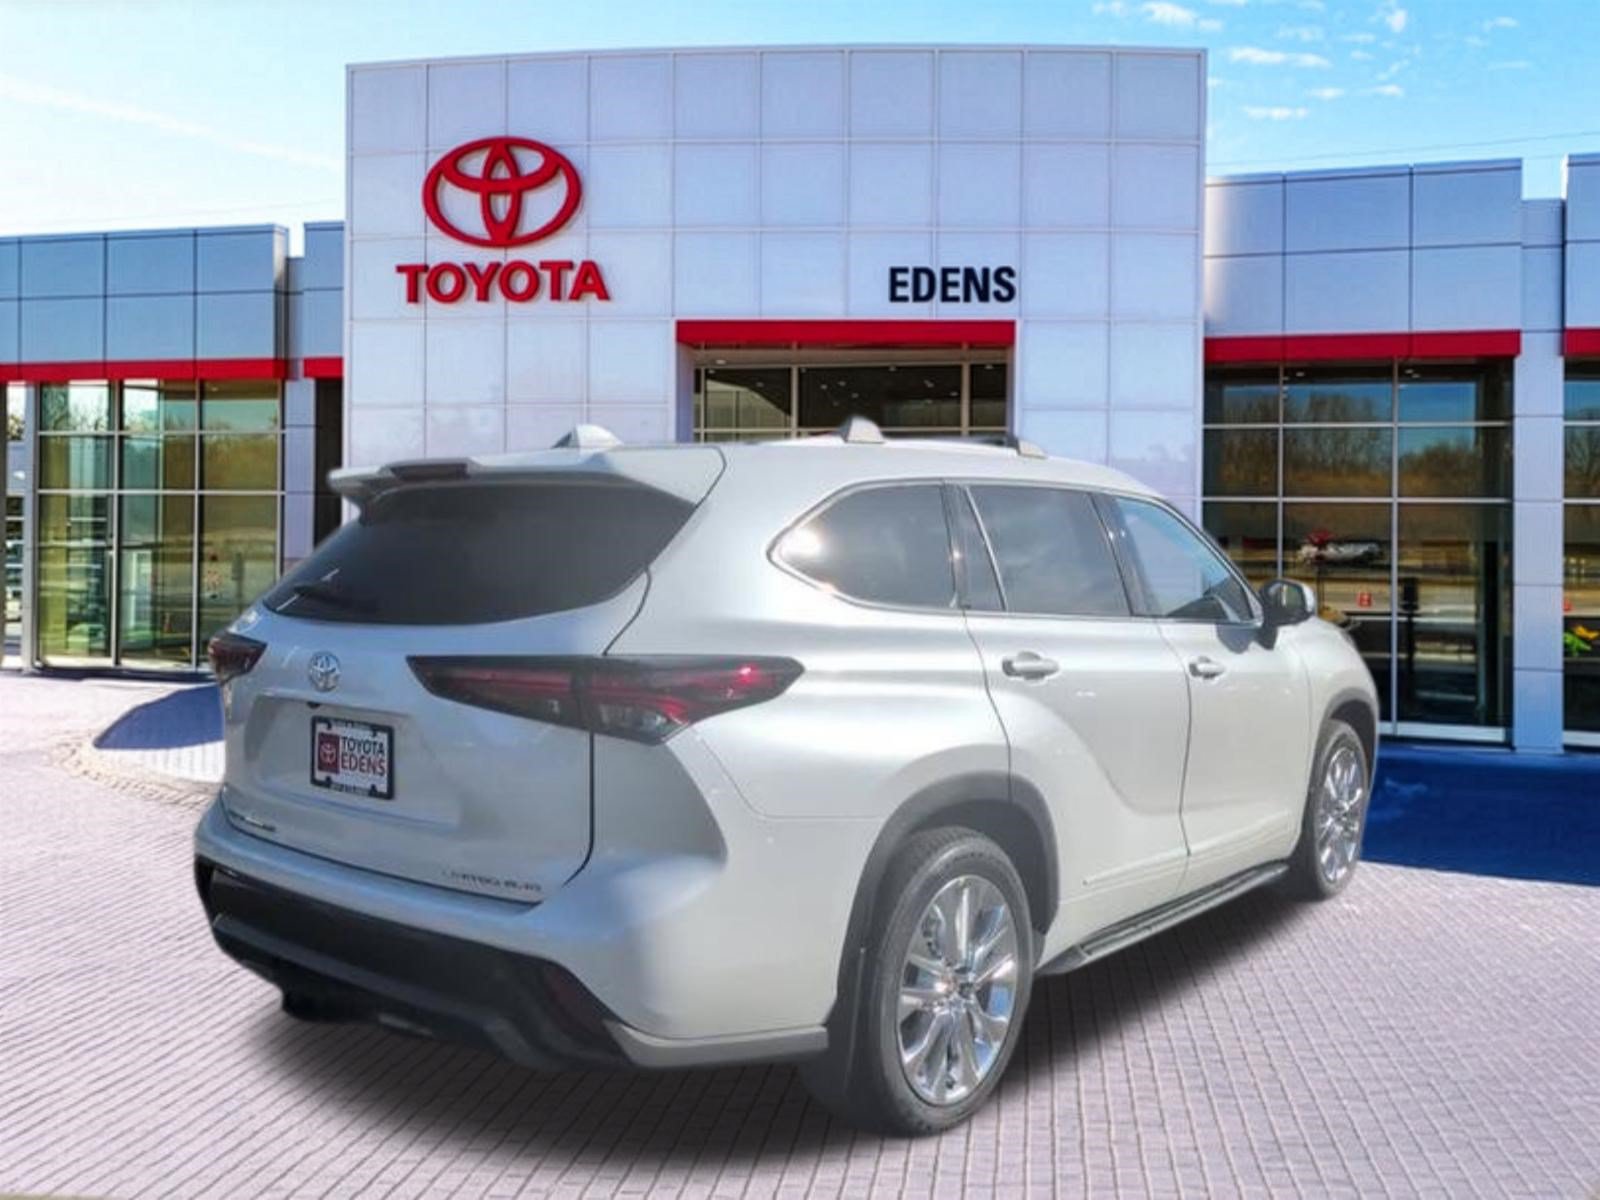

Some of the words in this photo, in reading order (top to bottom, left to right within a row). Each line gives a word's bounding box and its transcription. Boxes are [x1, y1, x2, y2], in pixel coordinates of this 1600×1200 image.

[396, 260, 611, 304] TOYOTA
[889, 266, 1017, 303] EDENS
[340, 736, 385, 756] TOYOTA
[341, 751, 386, 776] EDENS
